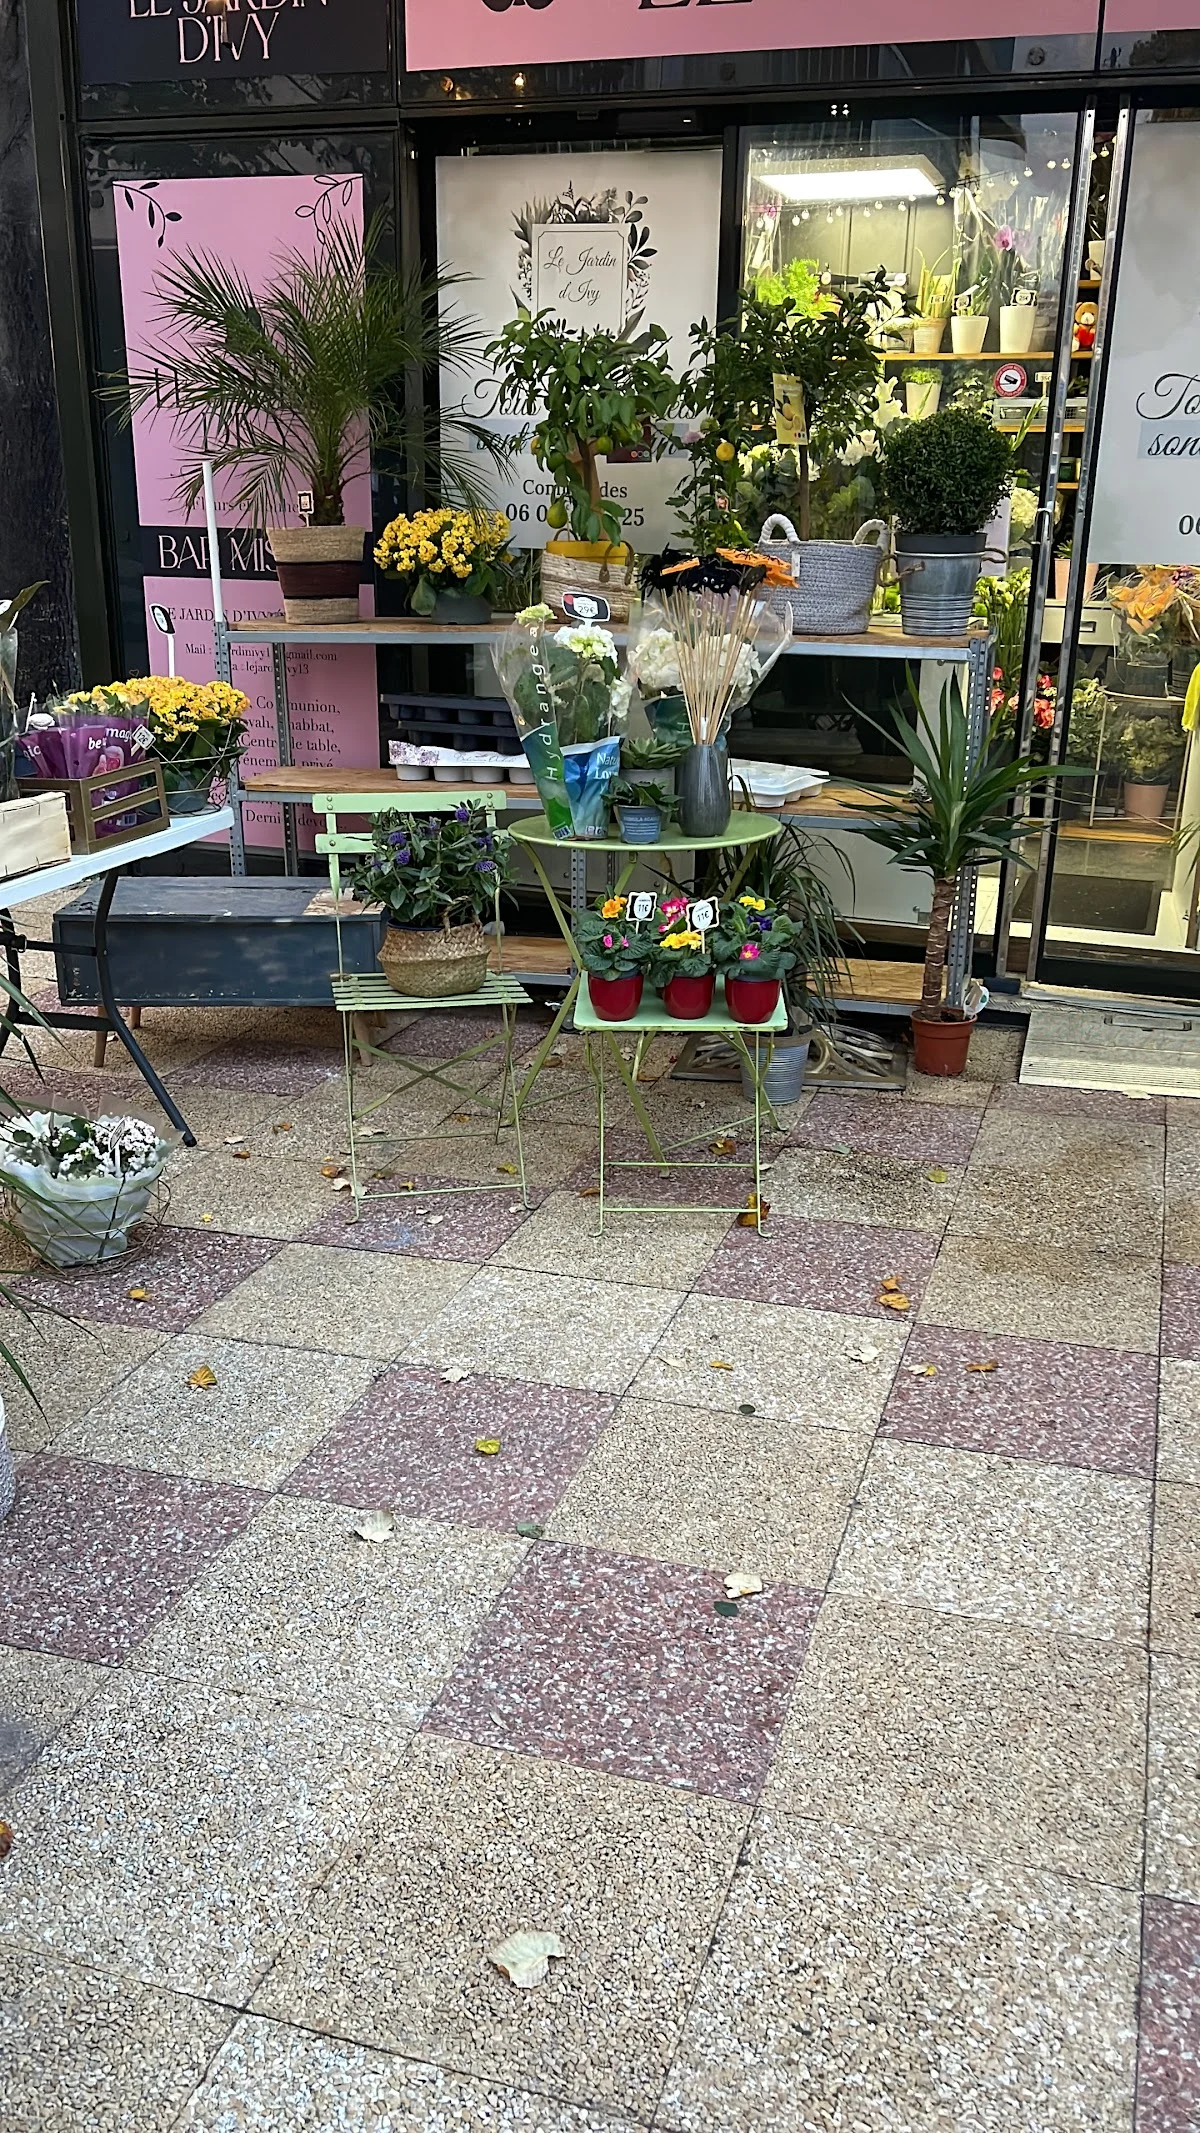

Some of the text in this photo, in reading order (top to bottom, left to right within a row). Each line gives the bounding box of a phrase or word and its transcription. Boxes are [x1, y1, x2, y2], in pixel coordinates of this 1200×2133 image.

[543, 245, 618, 276] Le Jardin
[1147, 433, 1200, 457] son
[505, 503, 530, 522] 06
[621, 507, 645, 527] 25
[185, 643, 206, 655] Mail
[529, 625, 561, 782] Hydrangea
[240, 733, 277, 748] Centr
[306, 738, 341, 754] table,
